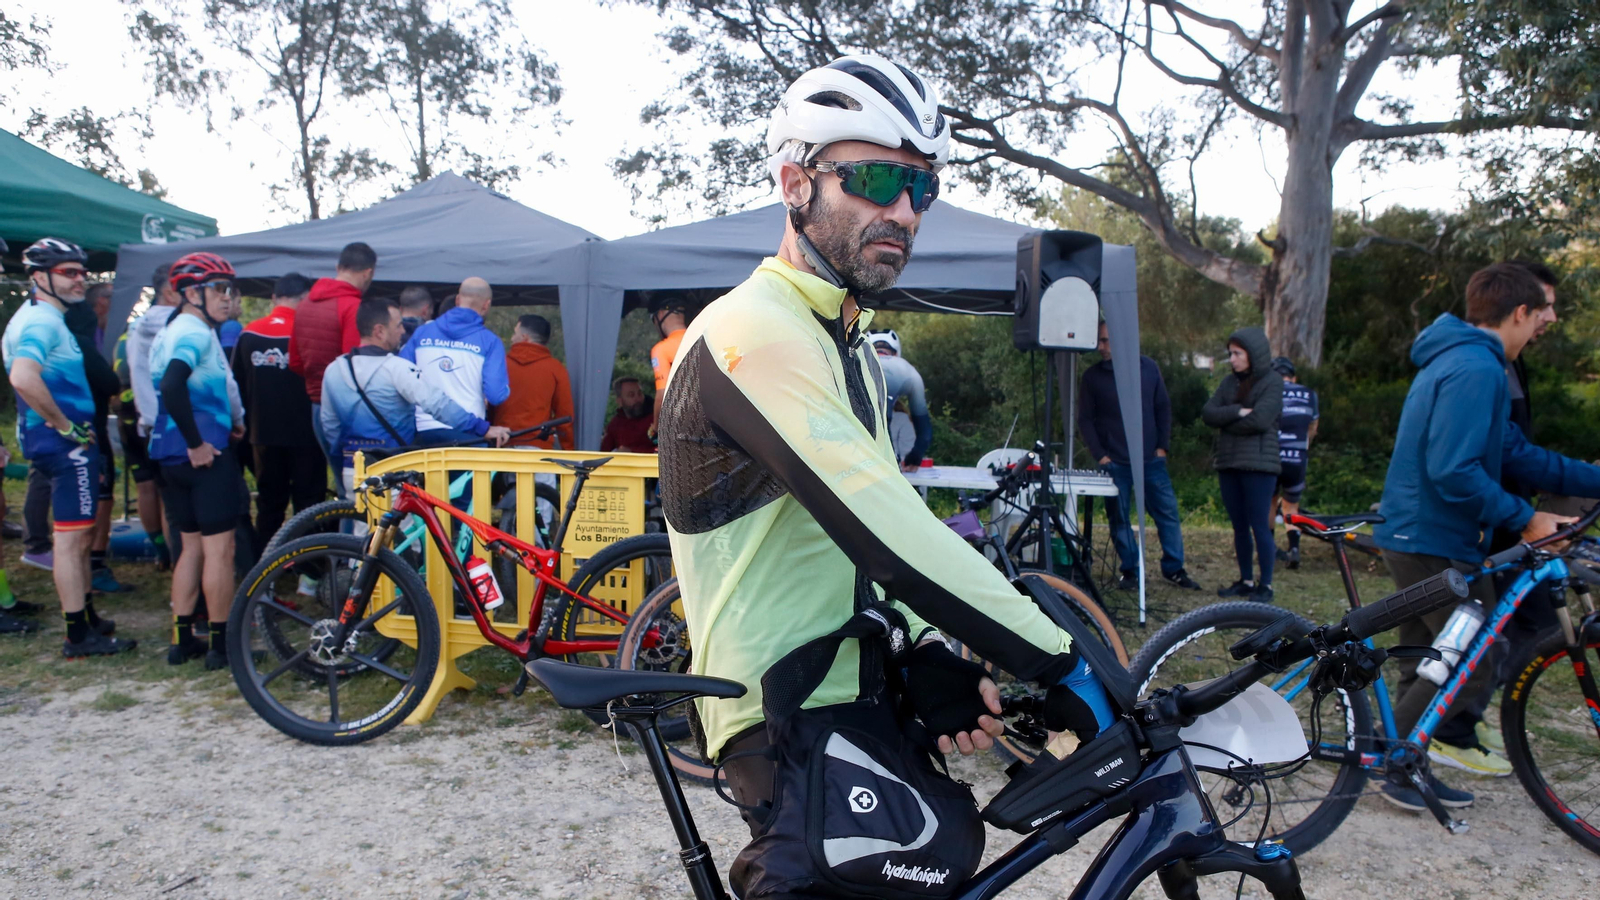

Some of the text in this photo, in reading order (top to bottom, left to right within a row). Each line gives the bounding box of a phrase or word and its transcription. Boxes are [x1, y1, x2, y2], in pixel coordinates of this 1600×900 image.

[434, 339, 450, 347] SAN
[451, 340, 481, 353] URBANO
[76, 466, 93, 516] movistar
[575, 524, 629, 534] Ayuntamiento
[575, 533, 627, 542] Los Barrio
[561, 598, 575, 641] PIRELL
[1511, 656, 1545, 701] MAXXIS
[1094, 757, 1124, 778] WILD MAN
